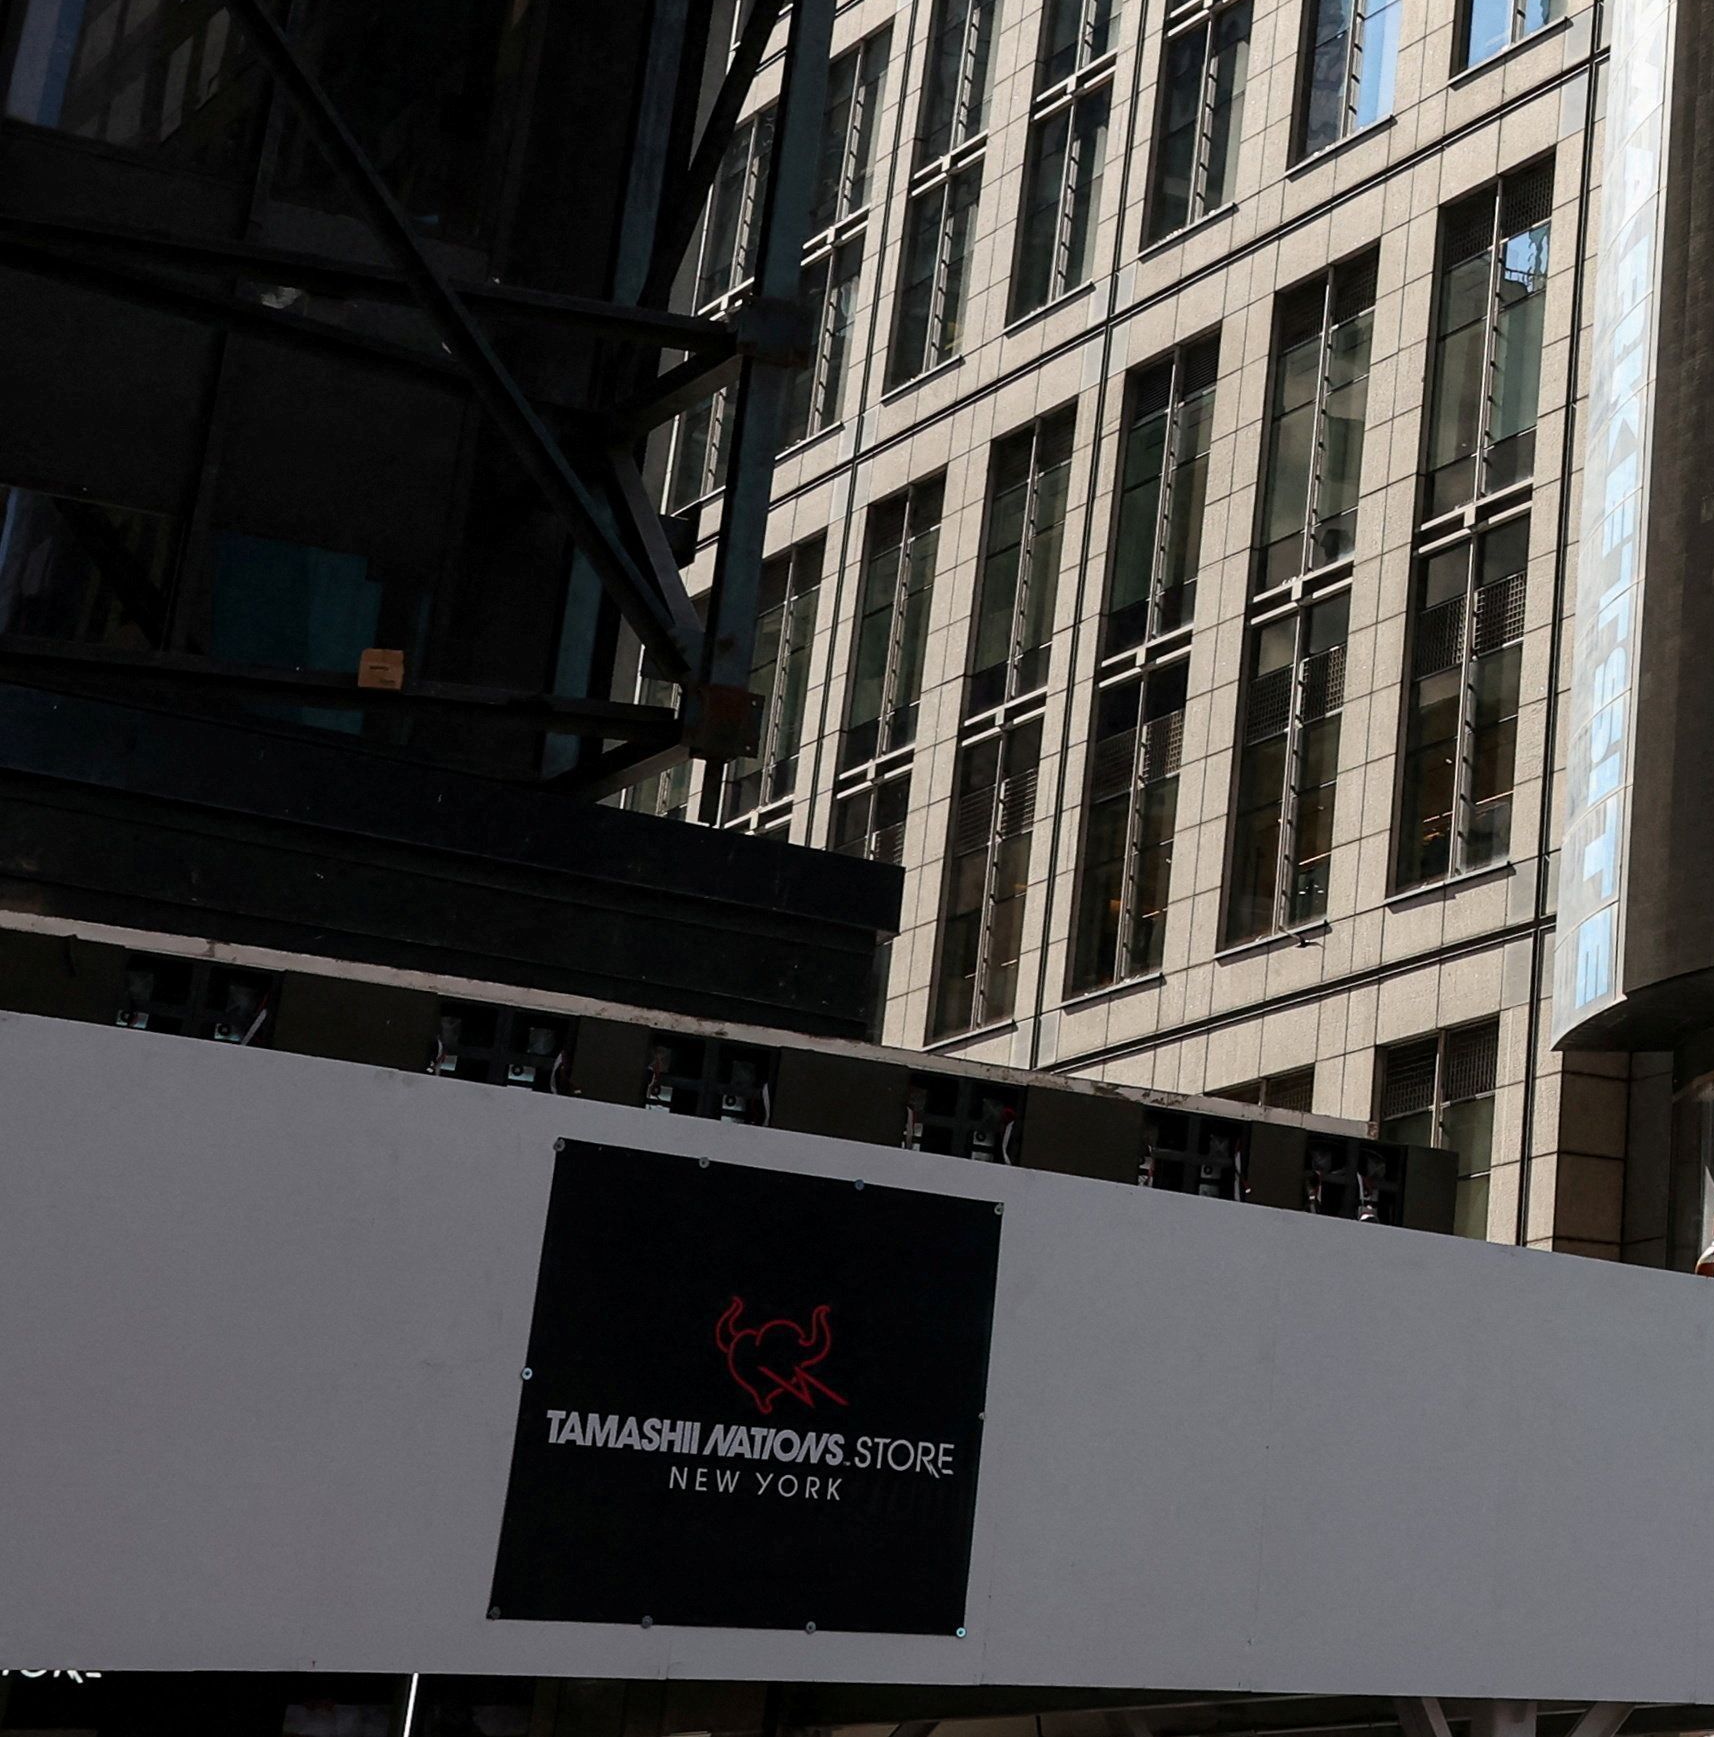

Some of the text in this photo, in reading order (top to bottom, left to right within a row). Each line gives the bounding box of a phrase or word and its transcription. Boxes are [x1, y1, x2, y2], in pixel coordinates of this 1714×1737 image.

[546, 1409, 955, 1478] TAMASHII NATIONS STORE
[669, 1466, 843, 1501] NEW YORK
